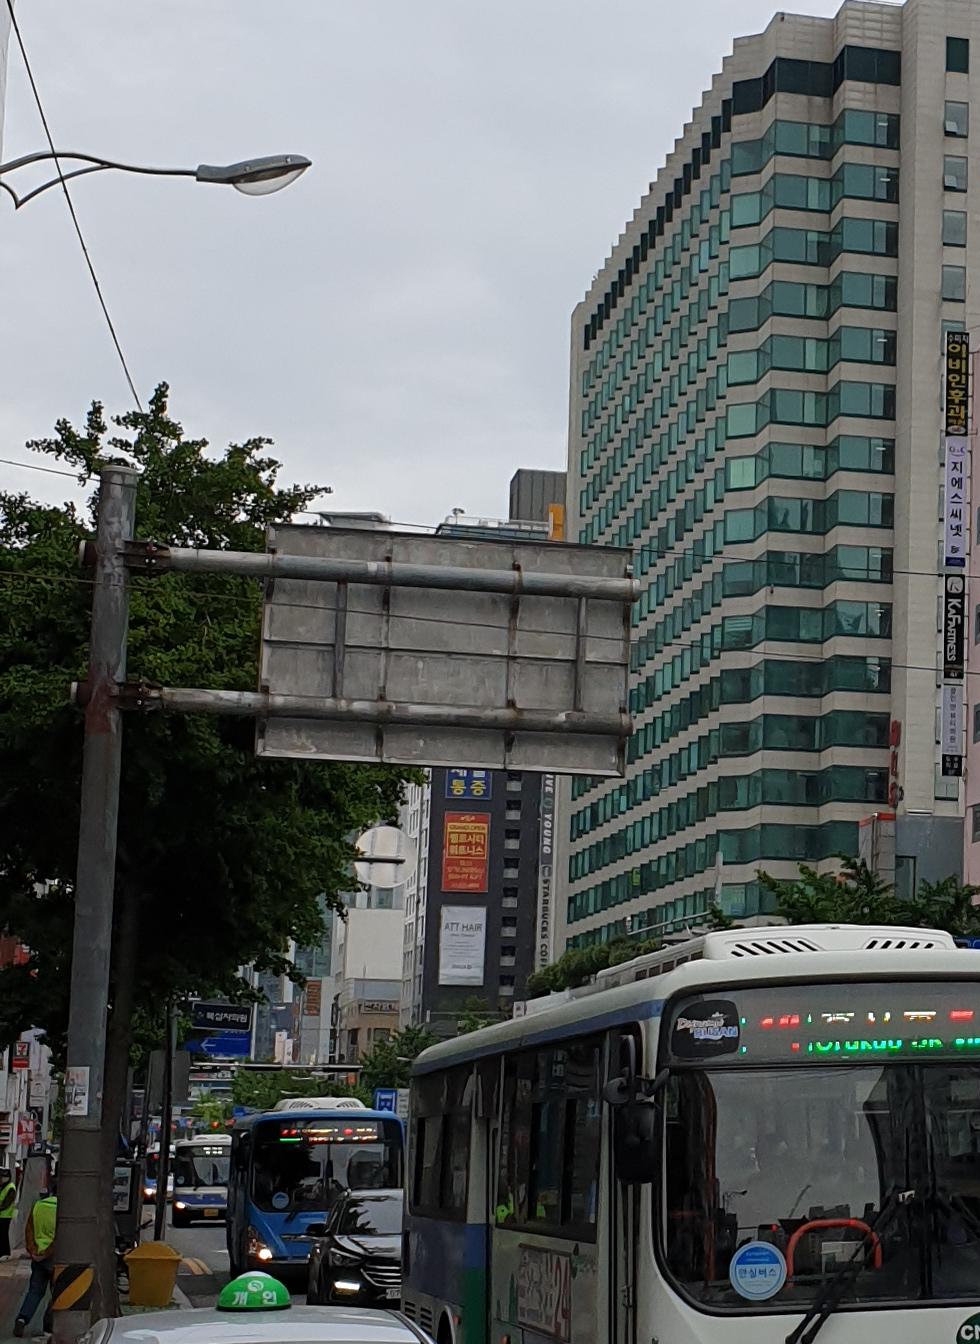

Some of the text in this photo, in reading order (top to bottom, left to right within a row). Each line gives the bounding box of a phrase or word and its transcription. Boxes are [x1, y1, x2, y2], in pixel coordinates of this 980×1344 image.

[950, 460, 964, 538] 지에스씨넷
[461, 922, 483, 932] HAIR
[693, 1025, 738, 1040] BUSAN
